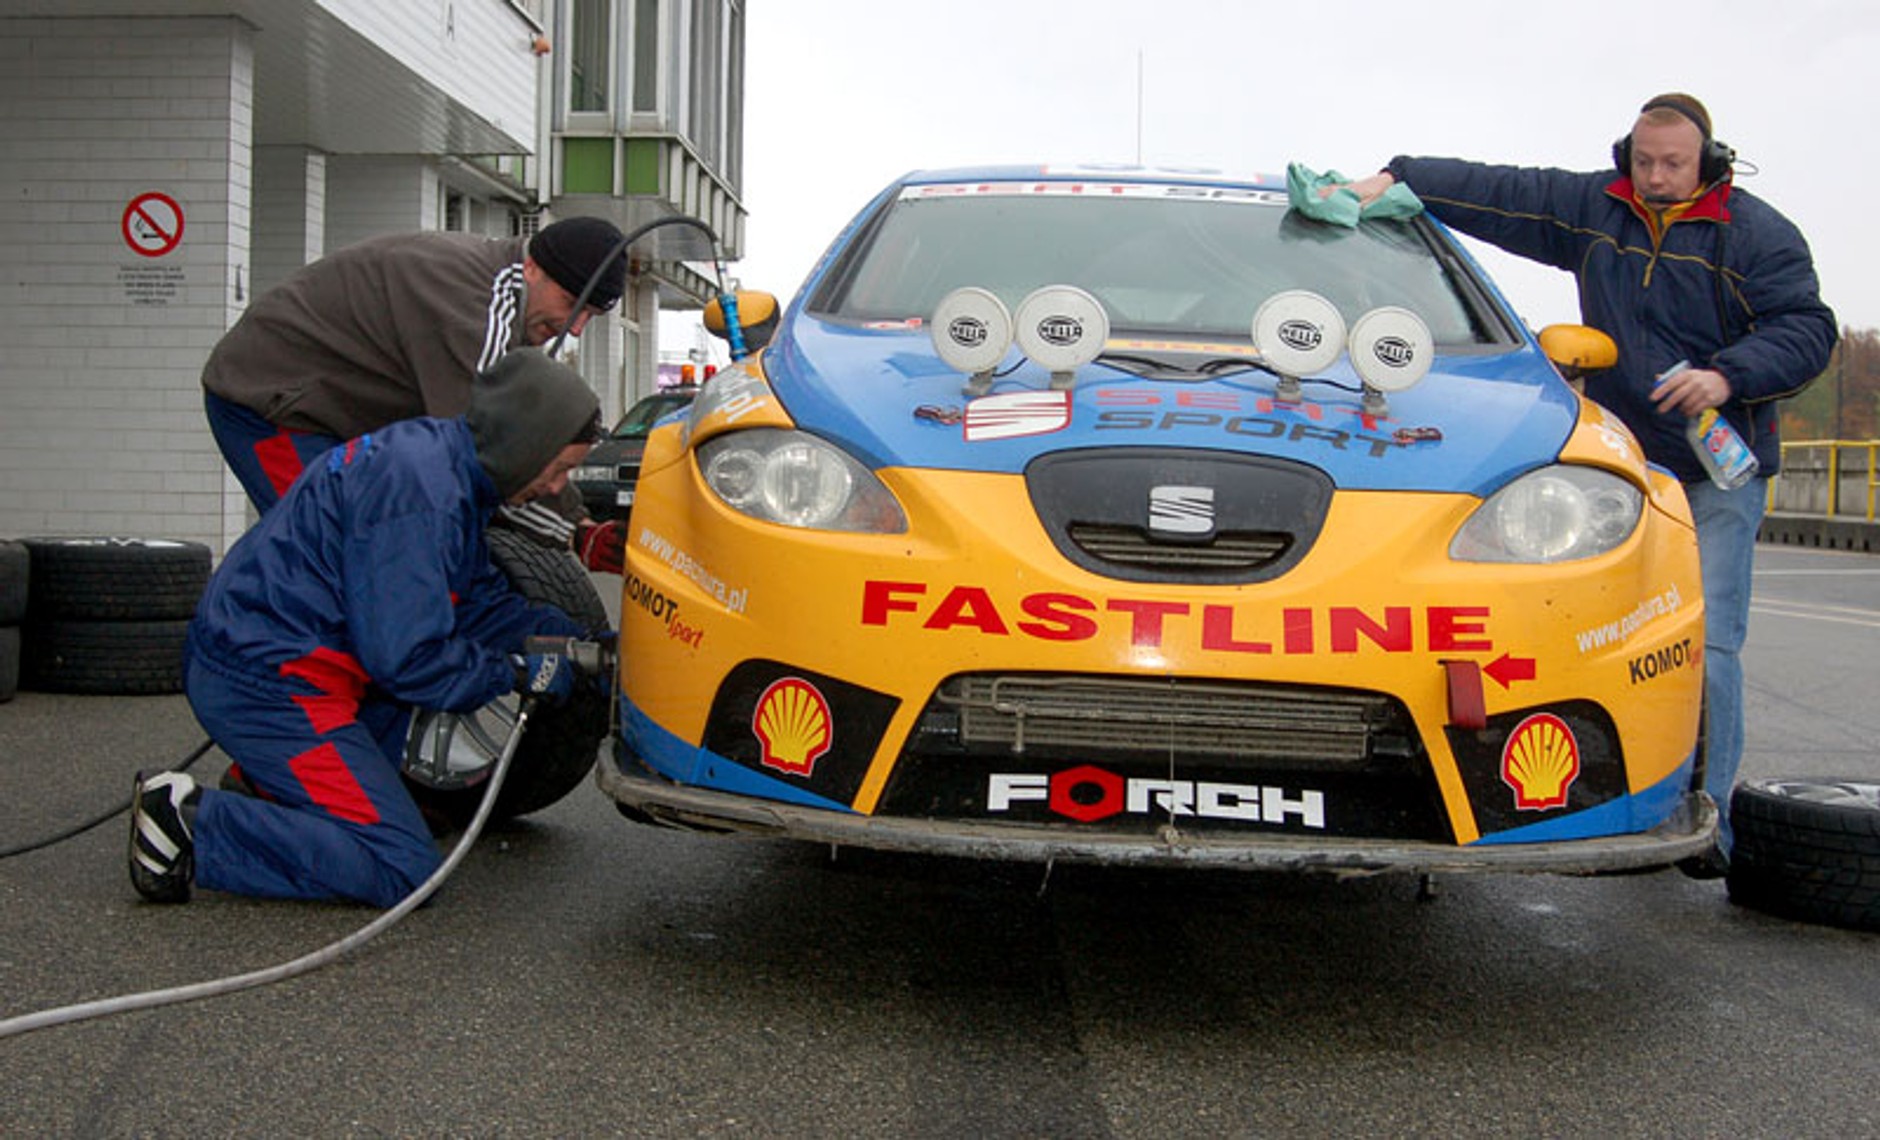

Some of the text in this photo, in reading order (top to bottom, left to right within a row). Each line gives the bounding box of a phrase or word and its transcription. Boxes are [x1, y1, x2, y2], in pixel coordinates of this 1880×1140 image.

[1163, 187, 1290, 201] SPO
[1095, 389, 1401, 431] SEAT
[1094, 411, 1407, 457] SPORT
[861, 579, 1493, 656] FASTLINE
[1628, 638, 1691, 685] KOMOT
[987, 764, 1325, 828] FORCH
